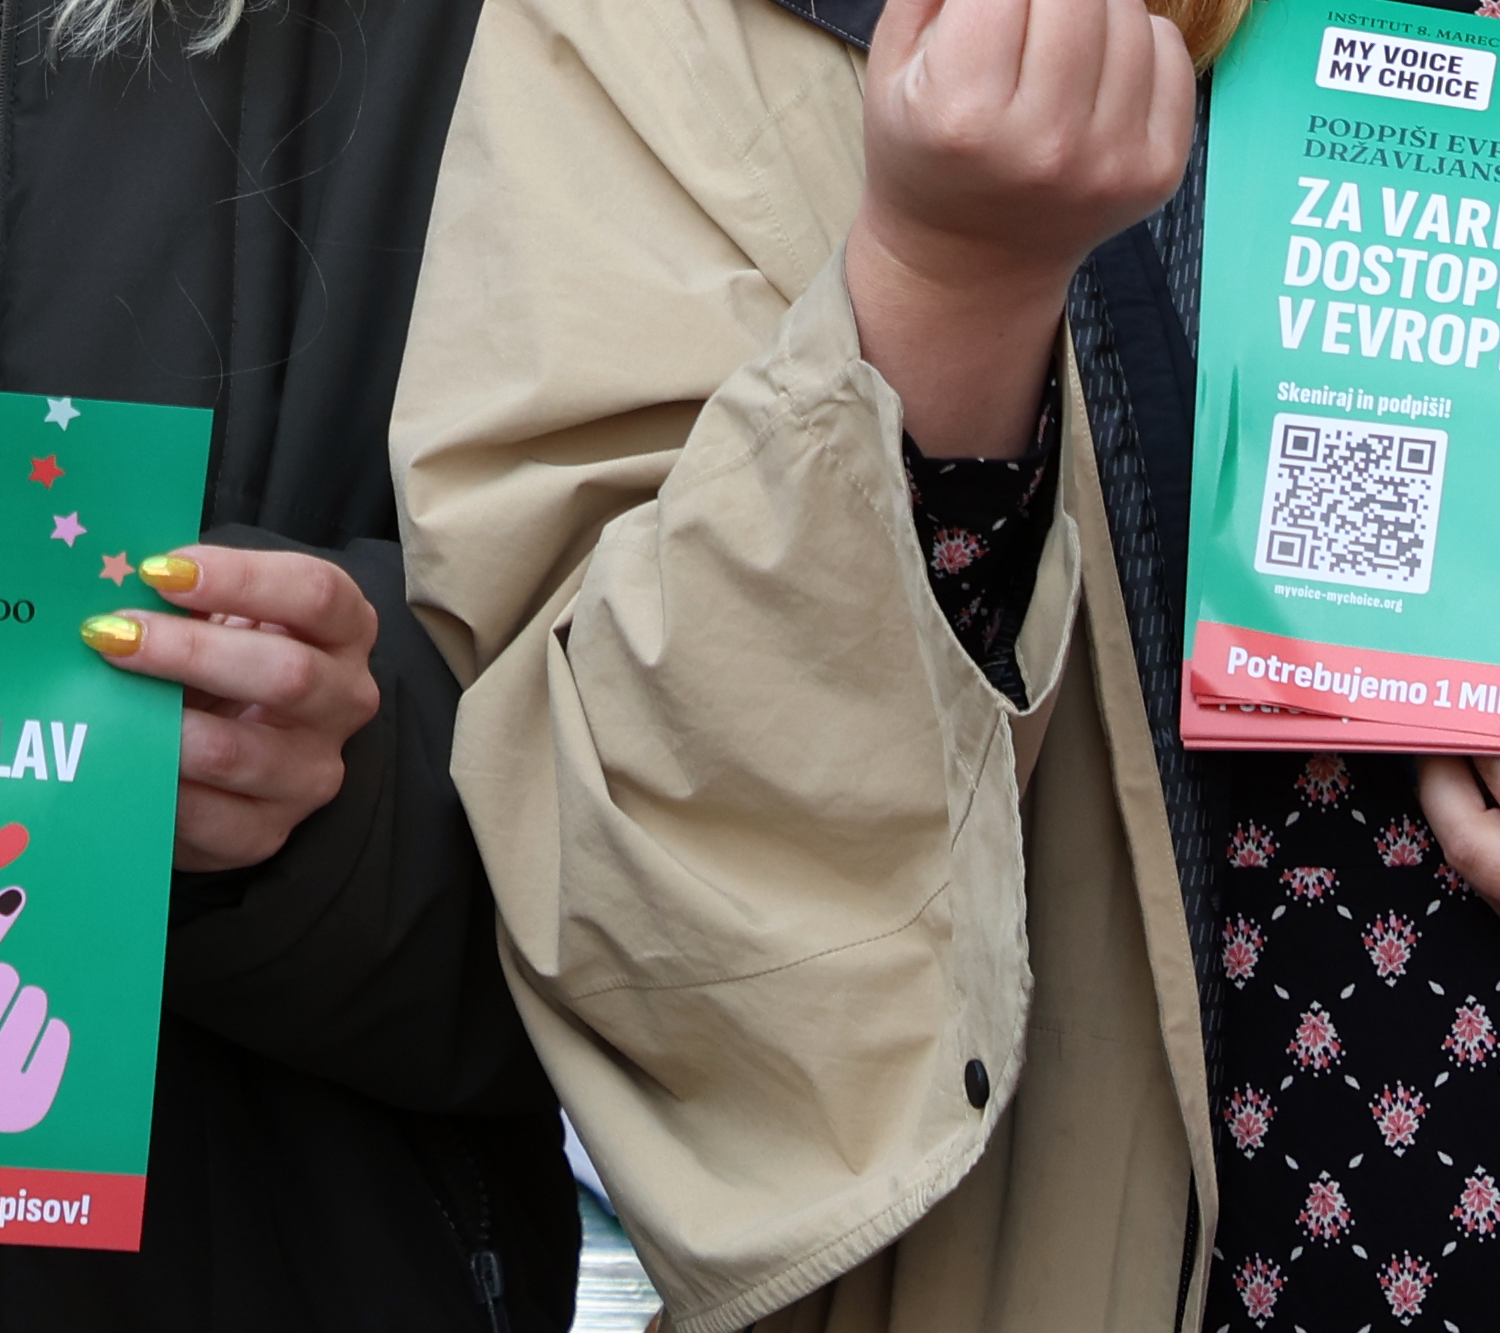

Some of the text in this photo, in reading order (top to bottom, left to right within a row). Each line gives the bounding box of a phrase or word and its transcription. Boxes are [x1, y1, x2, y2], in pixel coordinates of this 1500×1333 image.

[1327, 10, 1500, 49] INŠTITUT 8. MAREC
[1333, 37, 1464, 75] MY VOICE
[1328, 59, 1481, 101] MY CHOICE
[1306, 115, 1439, 151] PODPIŠI
[1290, 177, 1363, 232] ZA
[1277, 296, 1317, 350] V
[1277, 381, 1452, 421] Skeniraj in podpiši!
[1274, 582, 1403, 613] myvoice-mychoice.org
[1227, 646, 1427, 707] Potrebujemo
[1432, 680, 1452, 710] 1
